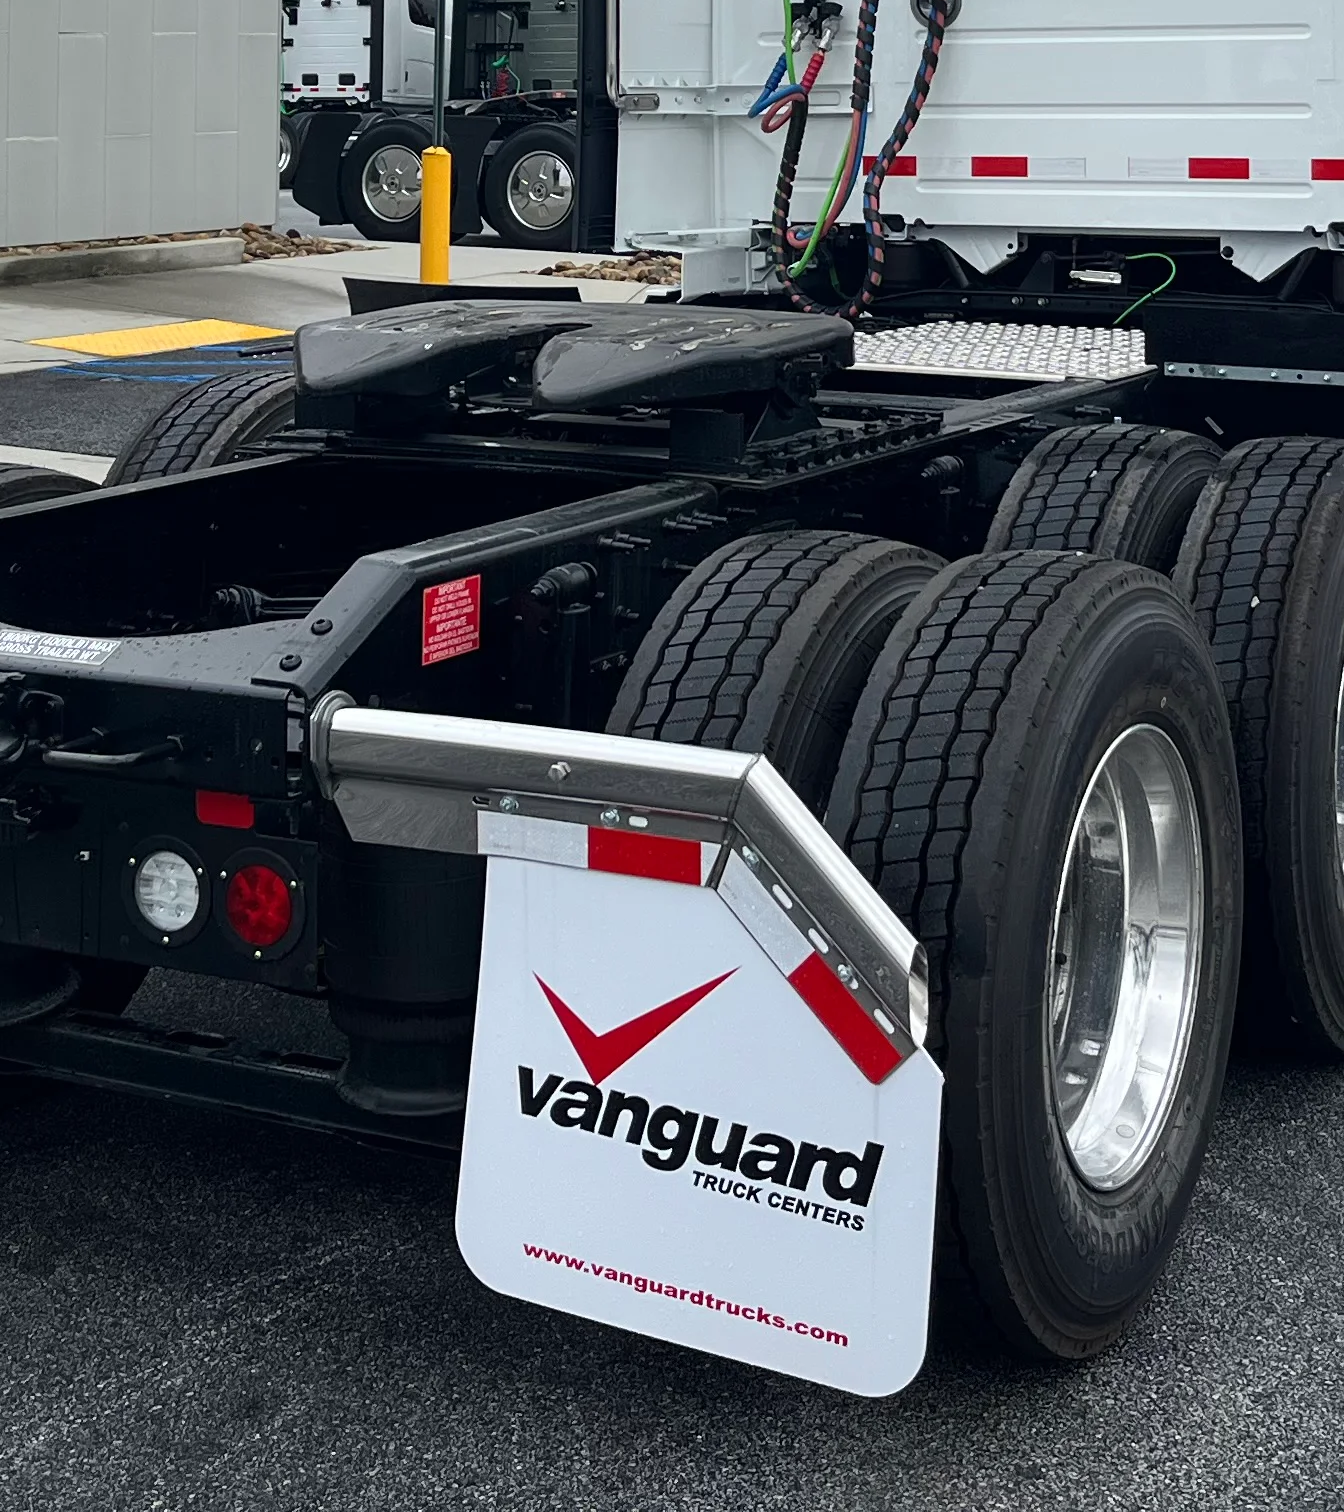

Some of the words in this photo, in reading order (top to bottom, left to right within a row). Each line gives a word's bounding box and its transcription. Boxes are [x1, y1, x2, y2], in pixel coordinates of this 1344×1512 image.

[34, 645, 81, 659] TRAILER
[79, 650, 101, 660] WT
[88, 641, 117, 652] MAX
[518, 1064, 885, 1208] vanguard
[692, 1170, 764, 1205] TRUCK
[767, 1191, 866, 1232] CENTERS
[523, 1243, 849, 1348] www.vanguardtrucks.com
